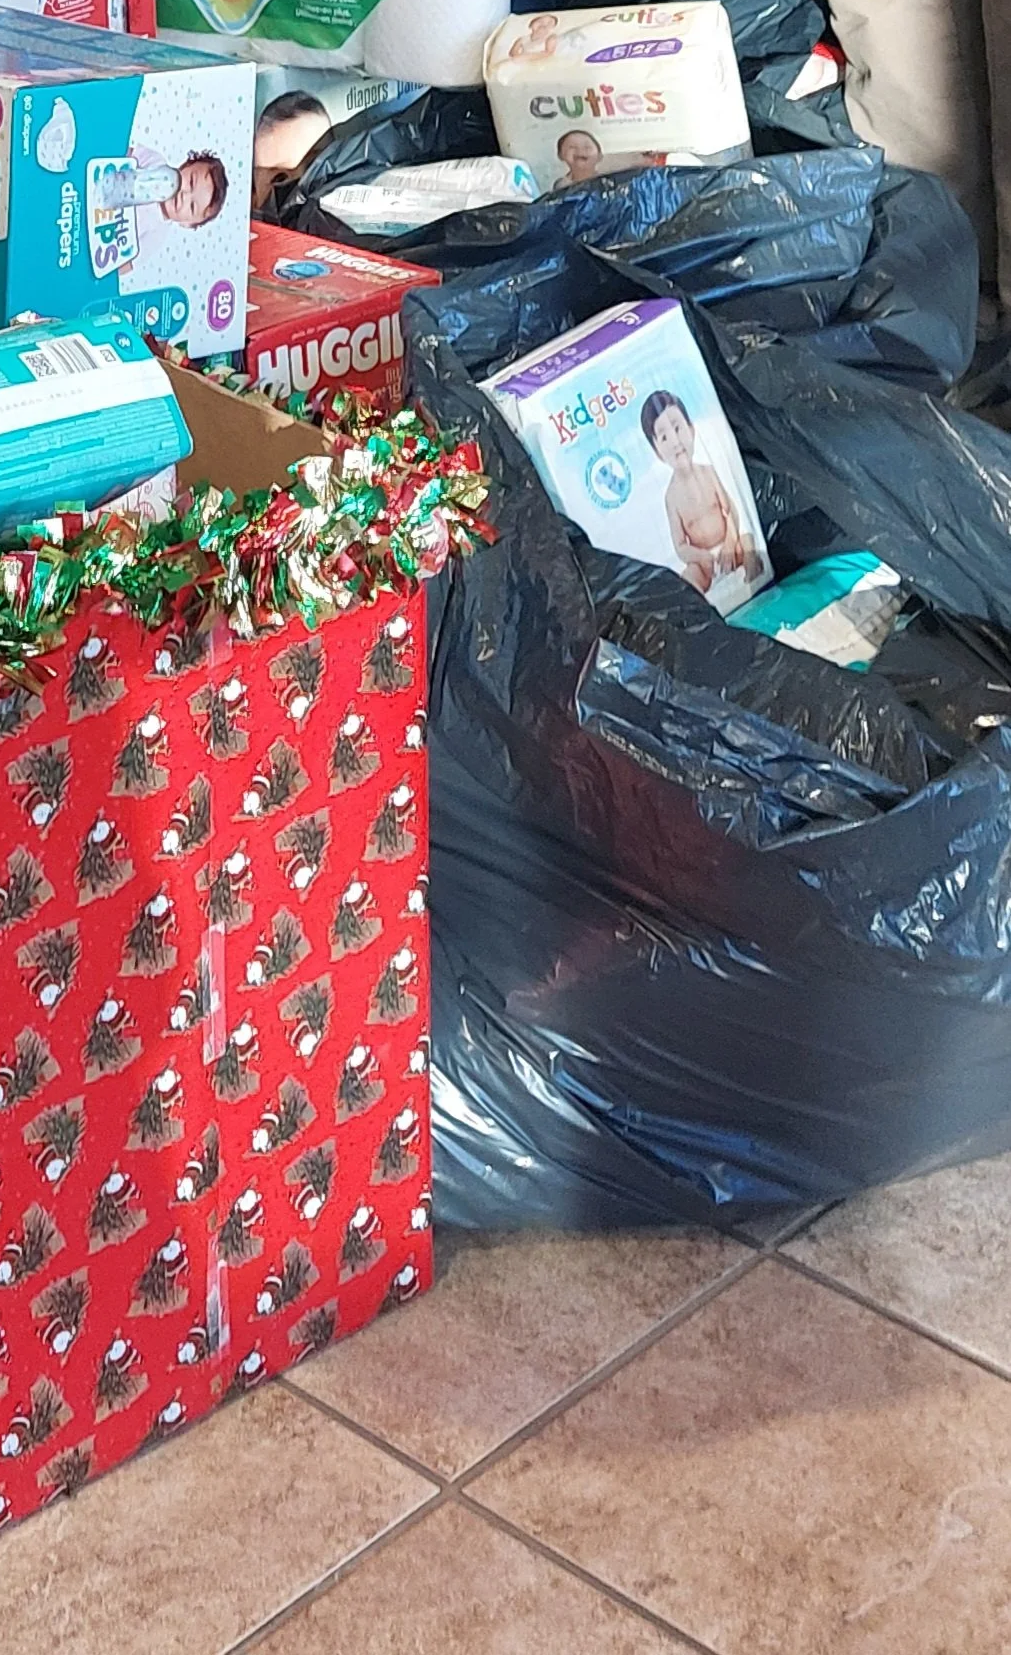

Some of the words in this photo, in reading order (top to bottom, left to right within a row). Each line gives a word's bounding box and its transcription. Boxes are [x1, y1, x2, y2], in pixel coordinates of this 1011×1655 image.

[600, 7, 685, 24] cuties
[346, 82, 389, 111] diapers
[529, 84, 666, 119] cuties
[22, 113, 33, 156] diapers
[57, 182, 77, 269] diapers
[115, 207, 130, 247] ntle
[304, 246, 419, 281] HUGGIES
[217, 290, 232, 320] 80
[549, 377, 636, 445] Kidgets
